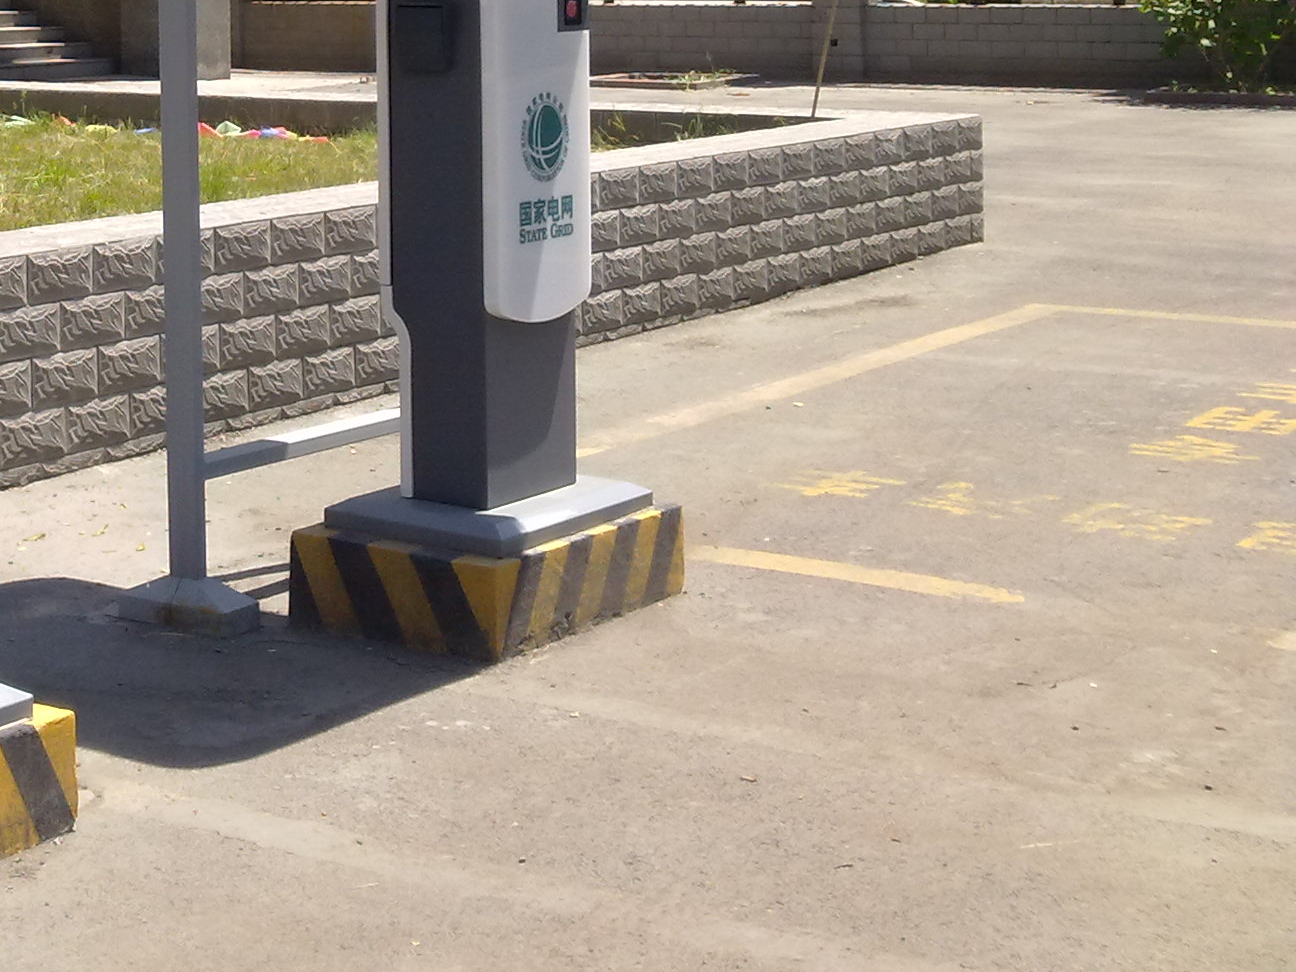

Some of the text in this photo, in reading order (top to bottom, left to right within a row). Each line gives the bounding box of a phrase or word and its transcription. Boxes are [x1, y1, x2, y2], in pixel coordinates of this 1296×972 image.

[517, 194, 574, 227] 国家电网
[519, 223, 574, 245] STATE GRID
